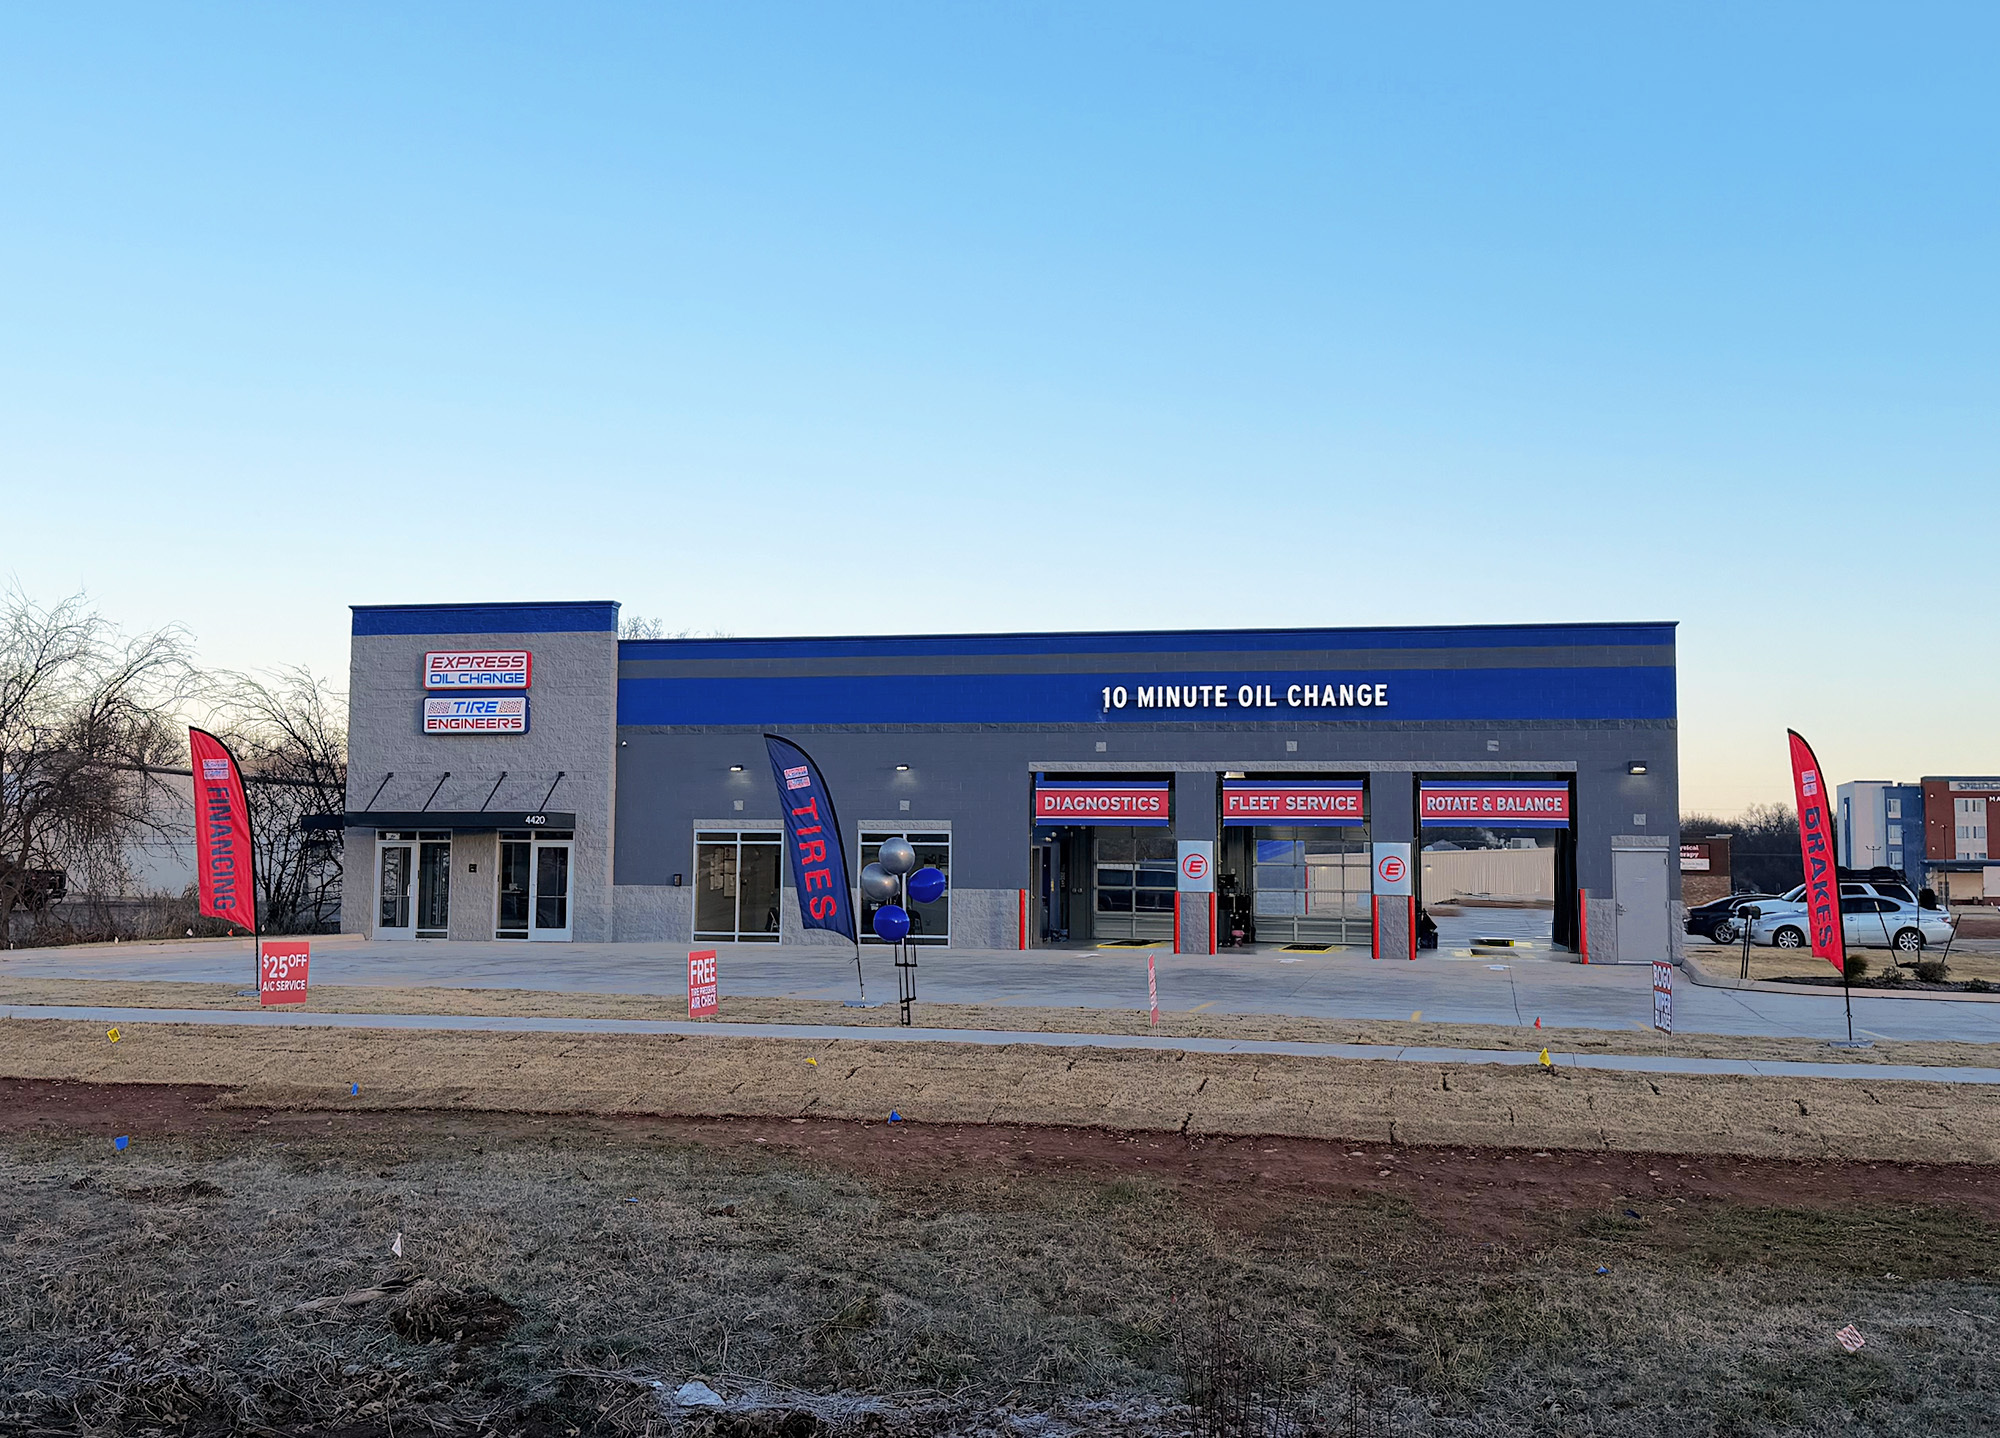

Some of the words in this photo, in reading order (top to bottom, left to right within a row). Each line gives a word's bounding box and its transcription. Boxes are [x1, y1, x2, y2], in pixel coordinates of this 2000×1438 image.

[431, 657, 524, 668] EXPRESS
[430, 674, 455, 684] OIL
[458, 673, 524, 683] CHANGE
[1102, 686, 1127, 709] 10
[1137, 685, 1228, 709] MINUTE
[1238, 685, 1277, 708] OIL
[1287, 684, 1388, 707] CHANGE
[453, 702, 498, 713] TIRE
[427, 718, 521, 729] ENGINEERS
[1044, 796, 1160, 811] DIAGNOSTICS
[1229, 796, 1280, 811] FLEET
[1286, 796, 1357, 811] SERVICE
[1427, 797, 1478, 811] ROTATE
[1482, 797, 1492, 811] &
[1497, 797, 1563, 812] BALANCE
[525, 815, 546, 825] 4420
[207, 787, 236, 911] FINANCING
[792, 797, 838, 920] TIRES
[1804, 806, 1834, 948] BRAKES
[288, 954, 307, 967] OFF
[691, 958, 715, 985] FREE
[262, 981, 275, 992] A/C
[276, 980, 306, 991] SERVICE
